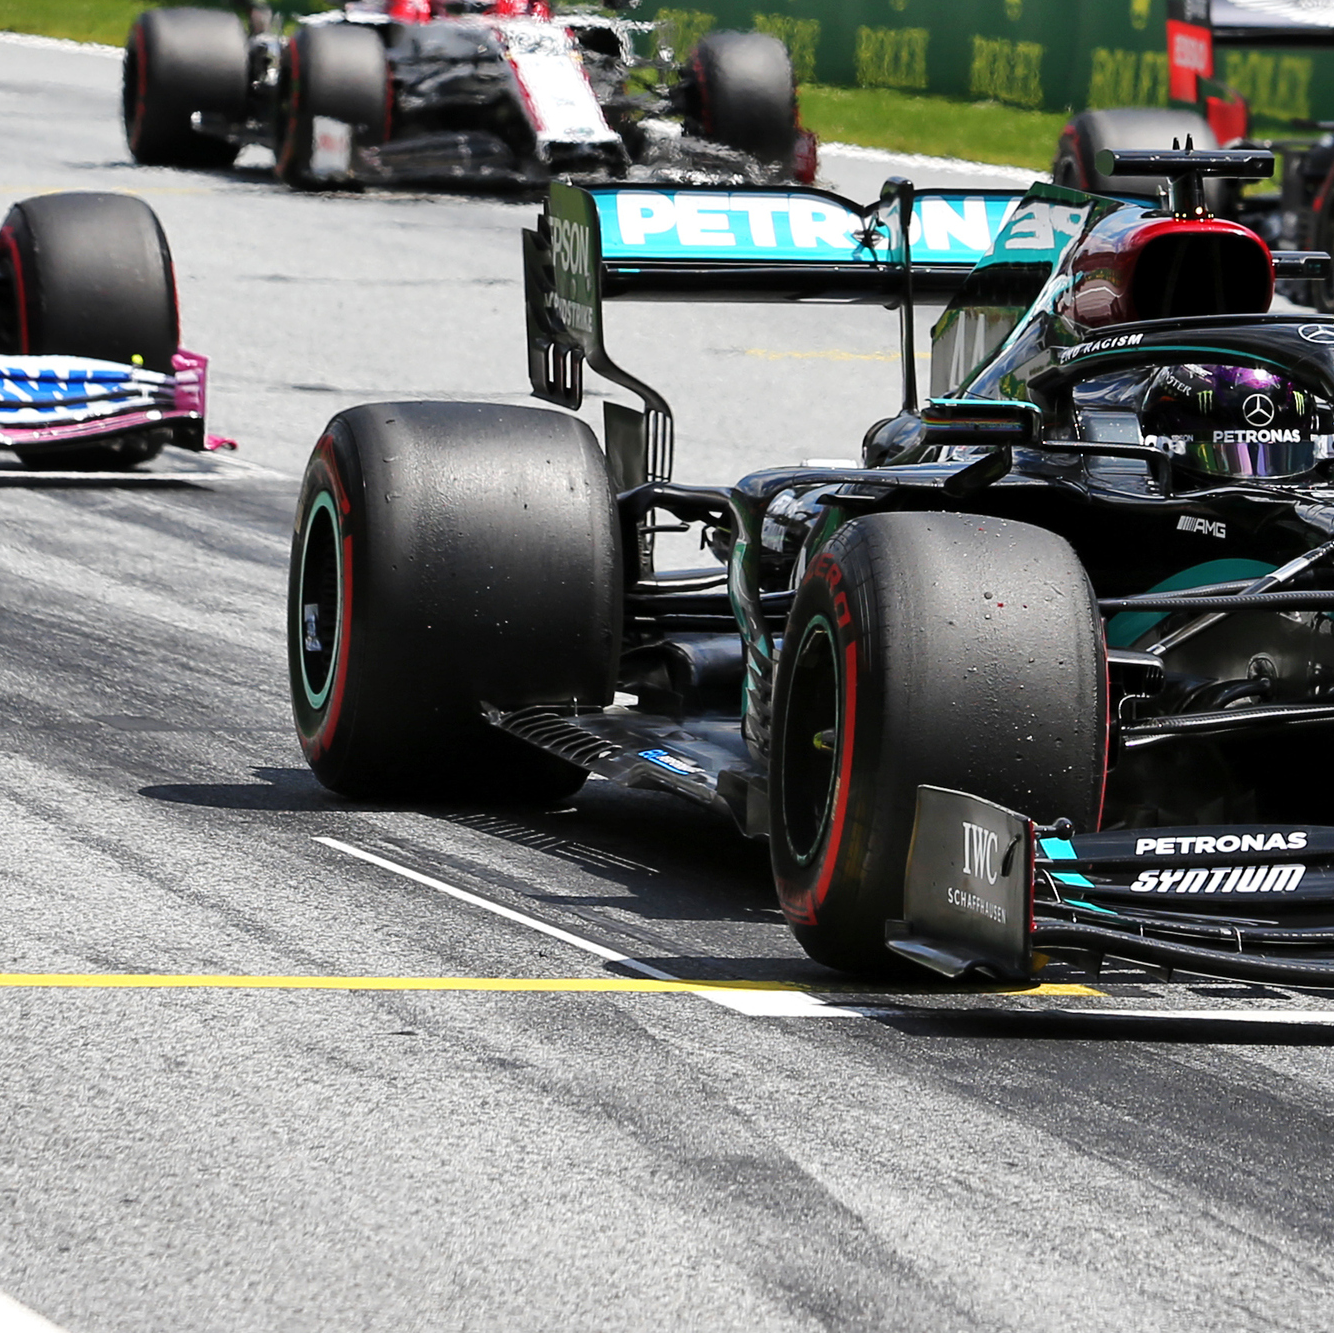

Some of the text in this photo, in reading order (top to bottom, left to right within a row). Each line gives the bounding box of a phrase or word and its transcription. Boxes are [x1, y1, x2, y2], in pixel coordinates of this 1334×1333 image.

[548, 215, 589, 277] PSON
[1083, 333, 1144, 354] RACISM
[1213, 429, 1301, 443] PETRONAS
[1195, 518, 1226, 539] AMG
[963, 822, 998, 885] IWC
[1135, 832, 1307, 855] PETRONAS
[1130, 864, 1306, 893] SYNTIUM
[947, 887, 1007, 925] SCHAFFHAUSEN
